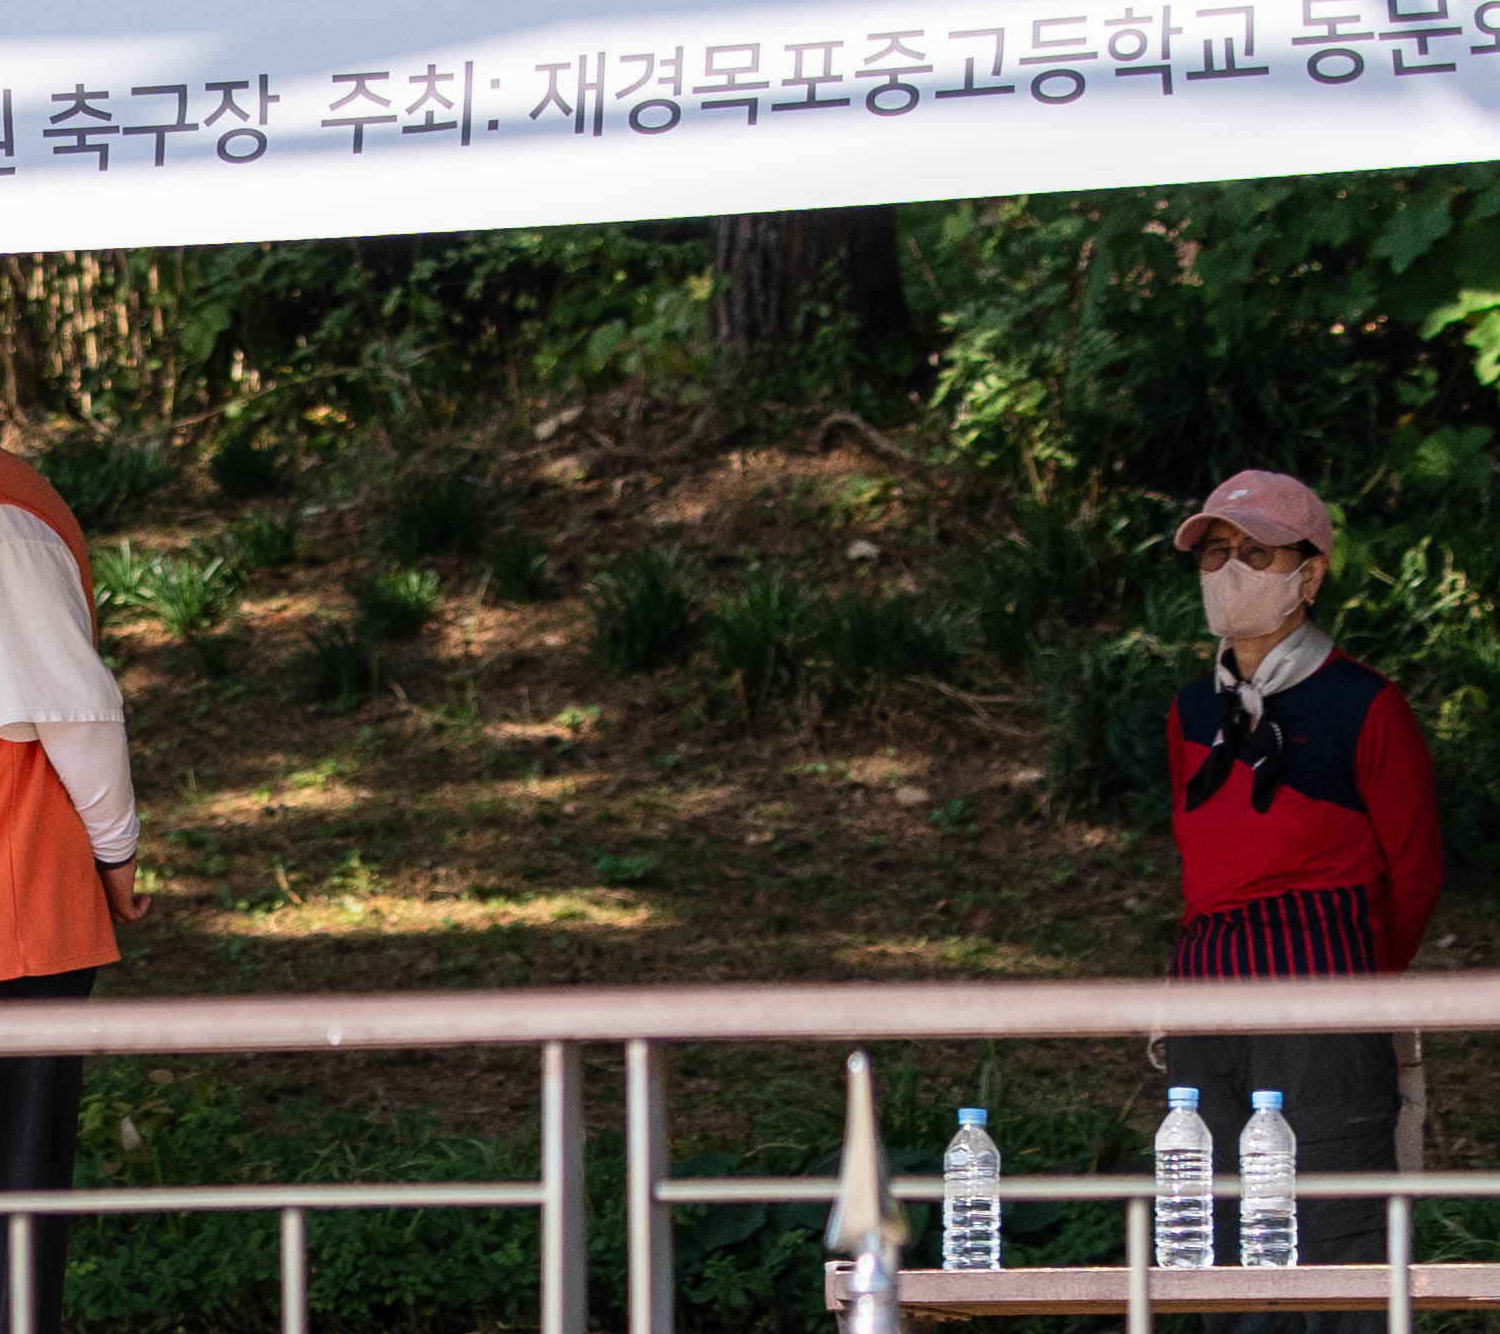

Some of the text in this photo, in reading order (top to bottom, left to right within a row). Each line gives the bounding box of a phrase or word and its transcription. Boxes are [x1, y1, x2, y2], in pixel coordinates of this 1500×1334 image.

[42, 73, 278, 172] 축구장
[321, 61, 501, 155] 주최:
[528, 10, 1270, 138] 재경목포중고등학교
